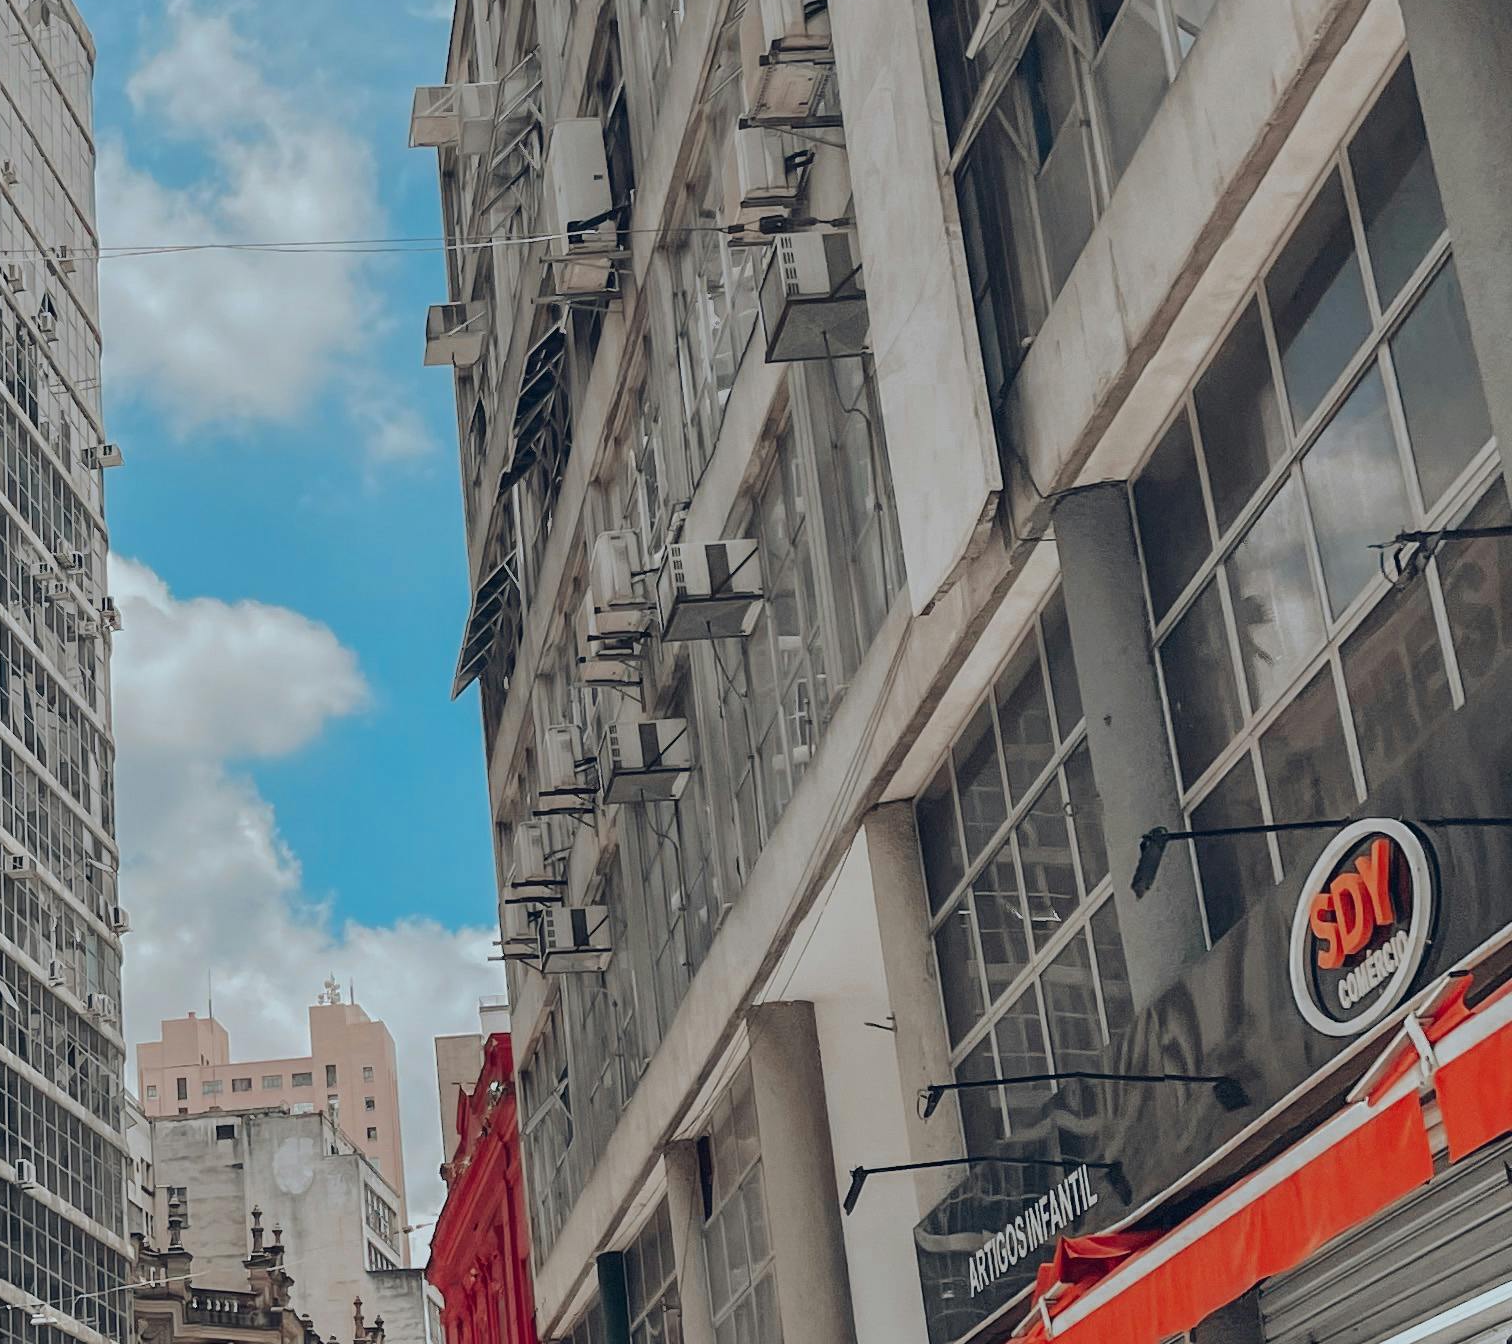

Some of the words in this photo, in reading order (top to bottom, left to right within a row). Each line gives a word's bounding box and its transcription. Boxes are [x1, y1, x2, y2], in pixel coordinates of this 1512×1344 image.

[1309, 839, 1395, 969] SDY
[969, 1215, 1028, 1298] ARTIGOS
[1025, 1164, 1098, 1252] INFANTIL
